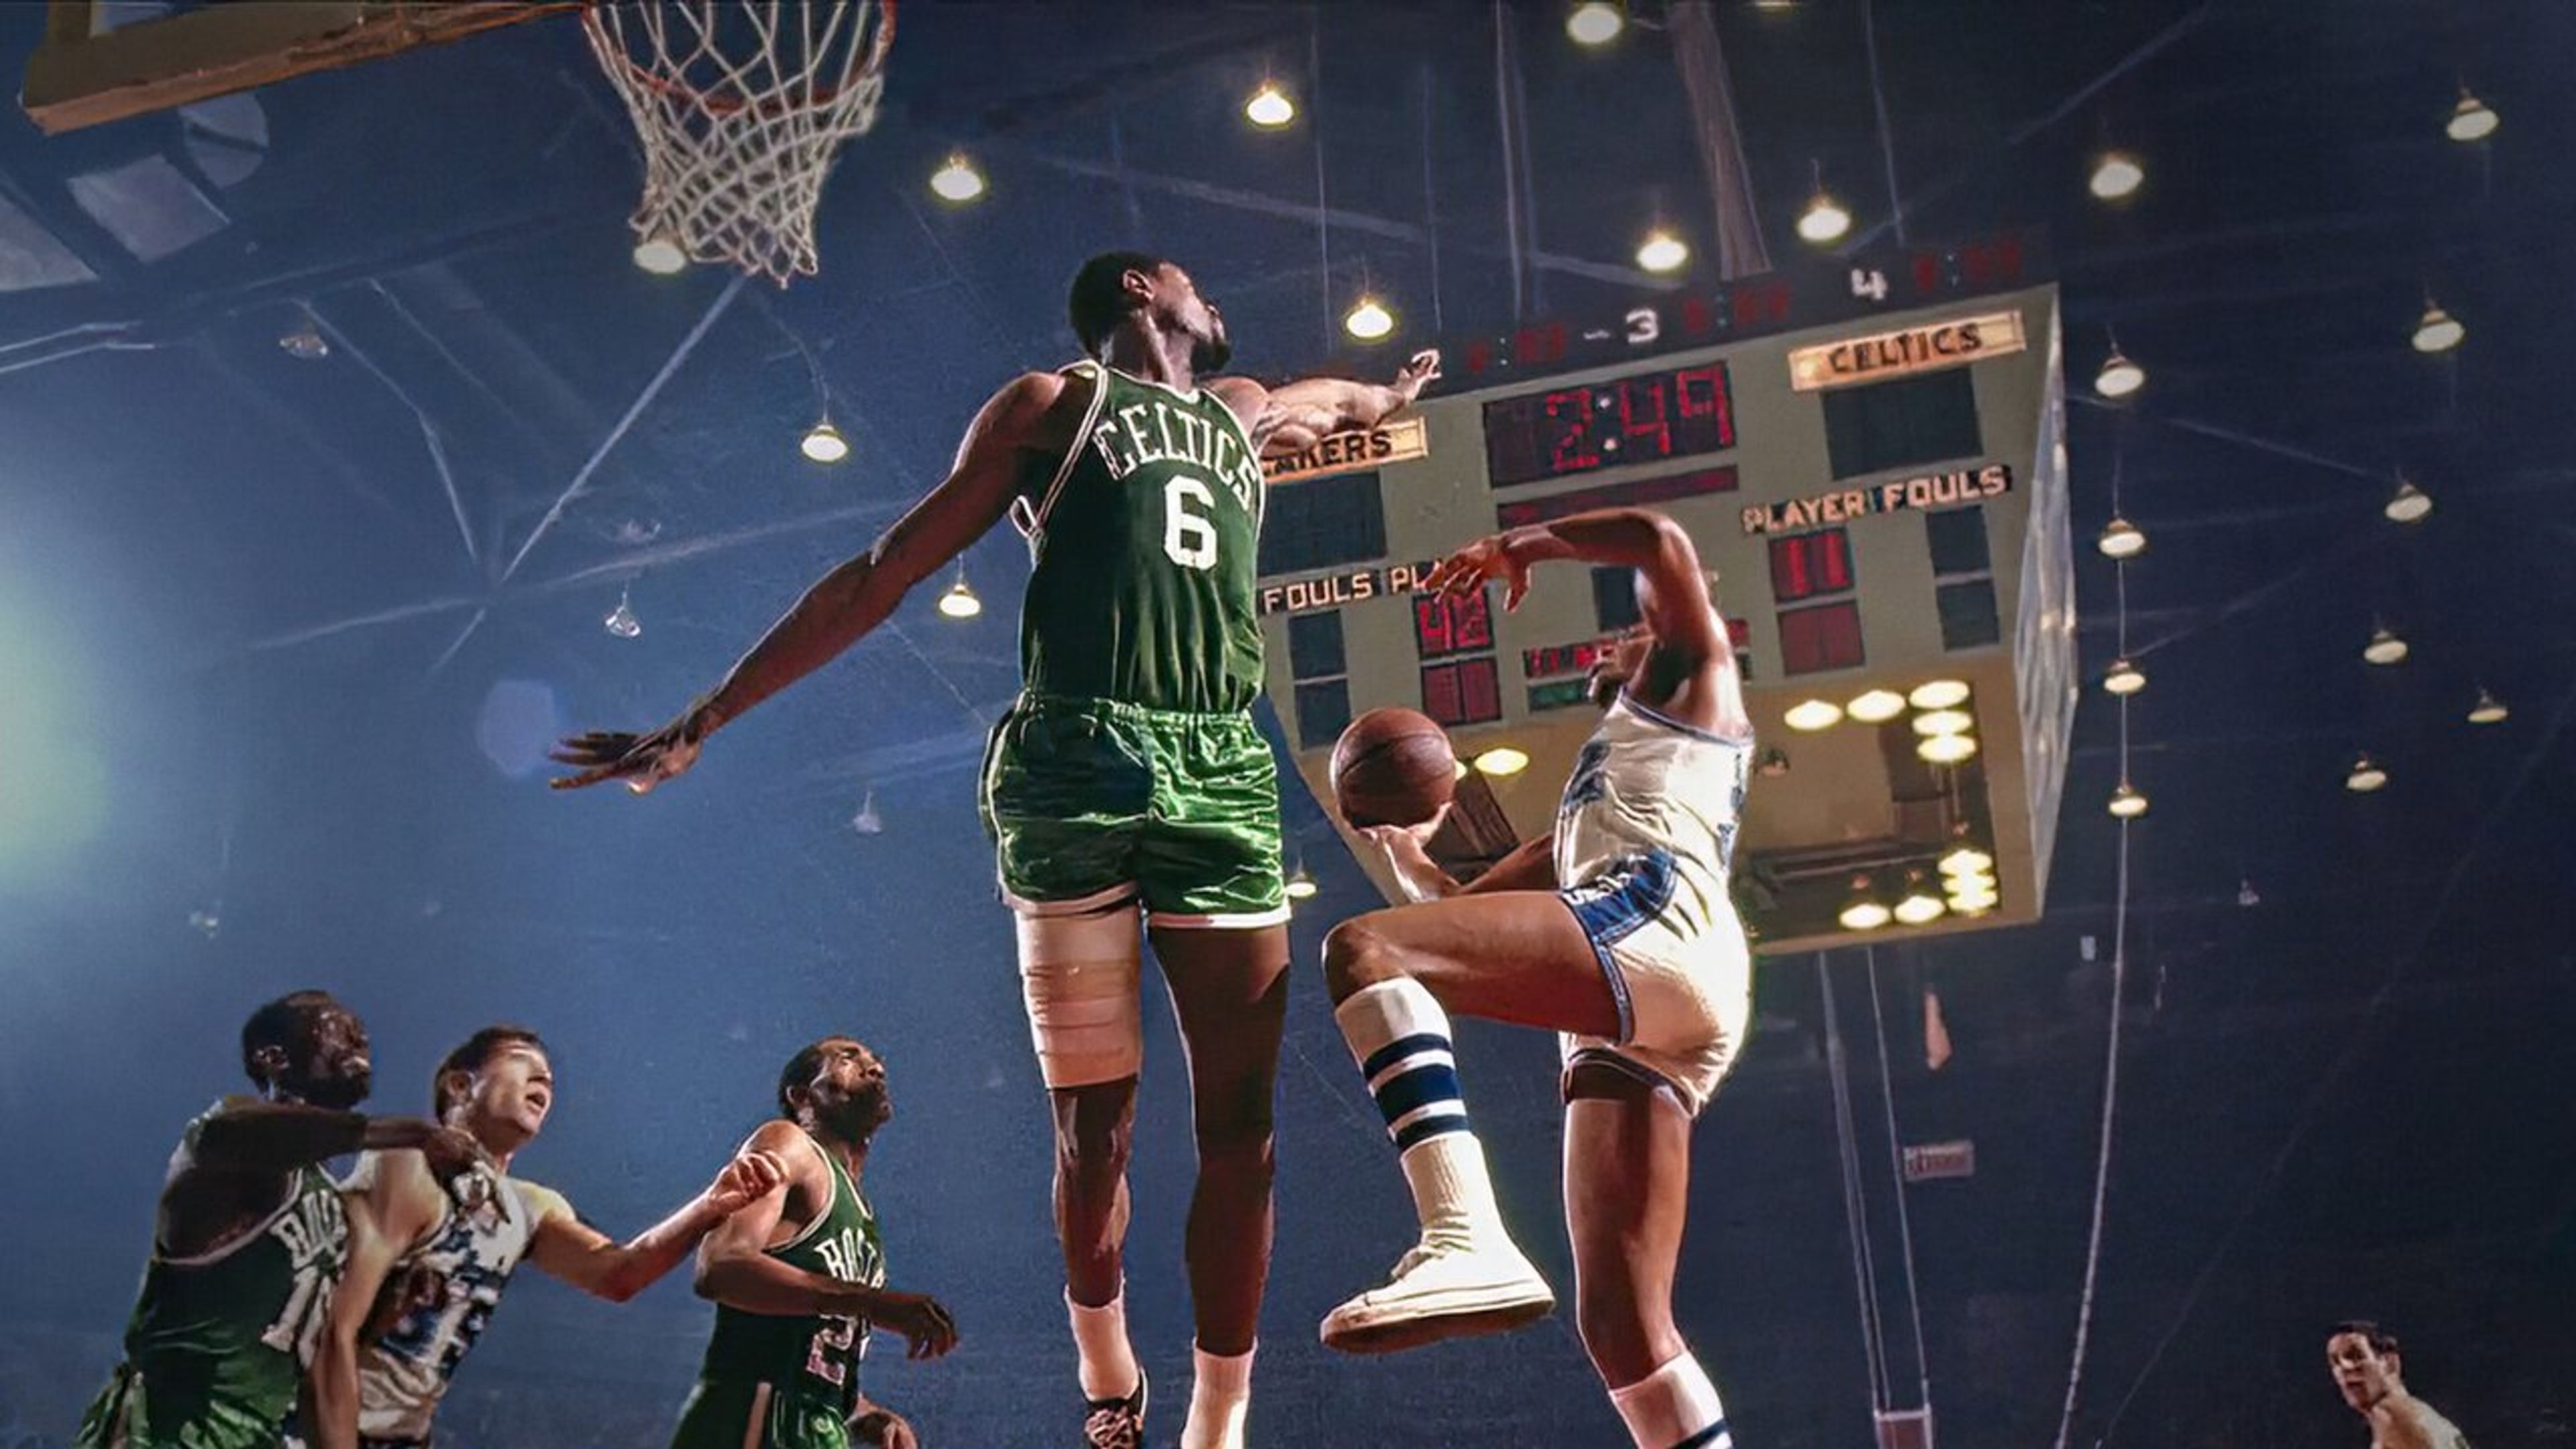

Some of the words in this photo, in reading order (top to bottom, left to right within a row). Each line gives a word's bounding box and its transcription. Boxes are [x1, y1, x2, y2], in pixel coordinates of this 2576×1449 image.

[1851, 269, 1887, 300] 4
[1625, 307, 1659, 343] 3
[1827, 324, 1984, 374] CELTICS
[1545, 366, 1733, 471] 2:49
[1093, 402, 1257, 511] CELTICS
[1163, 475, 1217, 570] 6
[1742, 488, 1865, 533] PLAYER
[1883, 465, 2008, 511] FOULS
[1264, 572, 1374, 615] FOULS
